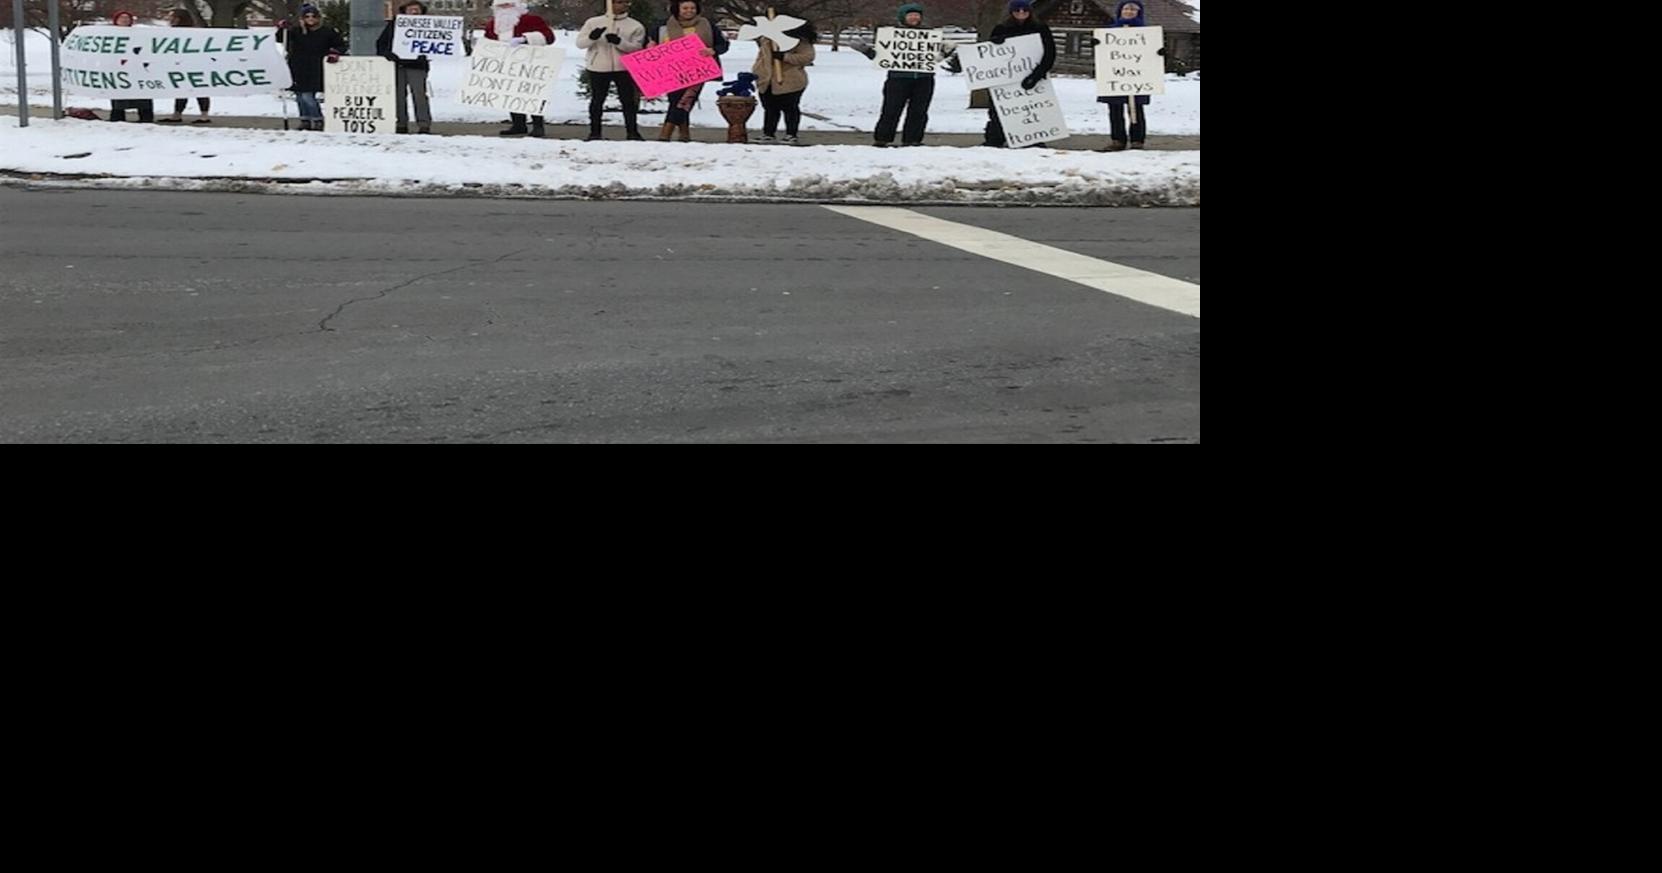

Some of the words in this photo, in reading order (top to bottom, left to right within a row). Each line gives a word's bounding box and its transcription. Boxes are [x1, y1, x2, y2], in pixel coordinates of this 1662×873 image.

[397, 17, 432, 28] GENESEE
[405, 29, 453, 41] CITIZENS
[893, 30, 938, 40] NON-
[1105, 32, 1147, 46] Don't
[151, 34, 271, 54] VALLEY
[410, 40, 455, 56] PEACE
[878, 40, 942, 52] VIOLENT
[977, 43, 1017, 59] Play
[632, 39, 693, 64] FORCE
[890, 52, 935, 61] VIDEO
[1110, 50, 1143, 63] Buy
[879, 59, 936, 71] GAMES
[966, 56, 1040, 82] Peacefull
[1112, 66, 1141, 77] War
[61, 67, 132, 89] ITIZENS
[138, 80, 166, 90] FOR
[167, 69, 272, 89] PEACE
[675, 63, 716, 85] WEAK
[517, 81, 547, 95] BUY
[993, 84, 1046, 101] Peace
[1106, 80, 1154, 94] Toys
[344, 95, 377, 107] BUY
[461, 90, 499, 108] WAR
[501, 94, 547, 114] TOYS!
[999, 99, 1055, 117] begins
[333, 107, 386, 120] PEACEFUL
[1022, 112, 1040, 125] at
[342, 119, 376, 134] TOYS
[1007, 126, 1060, 145] home
